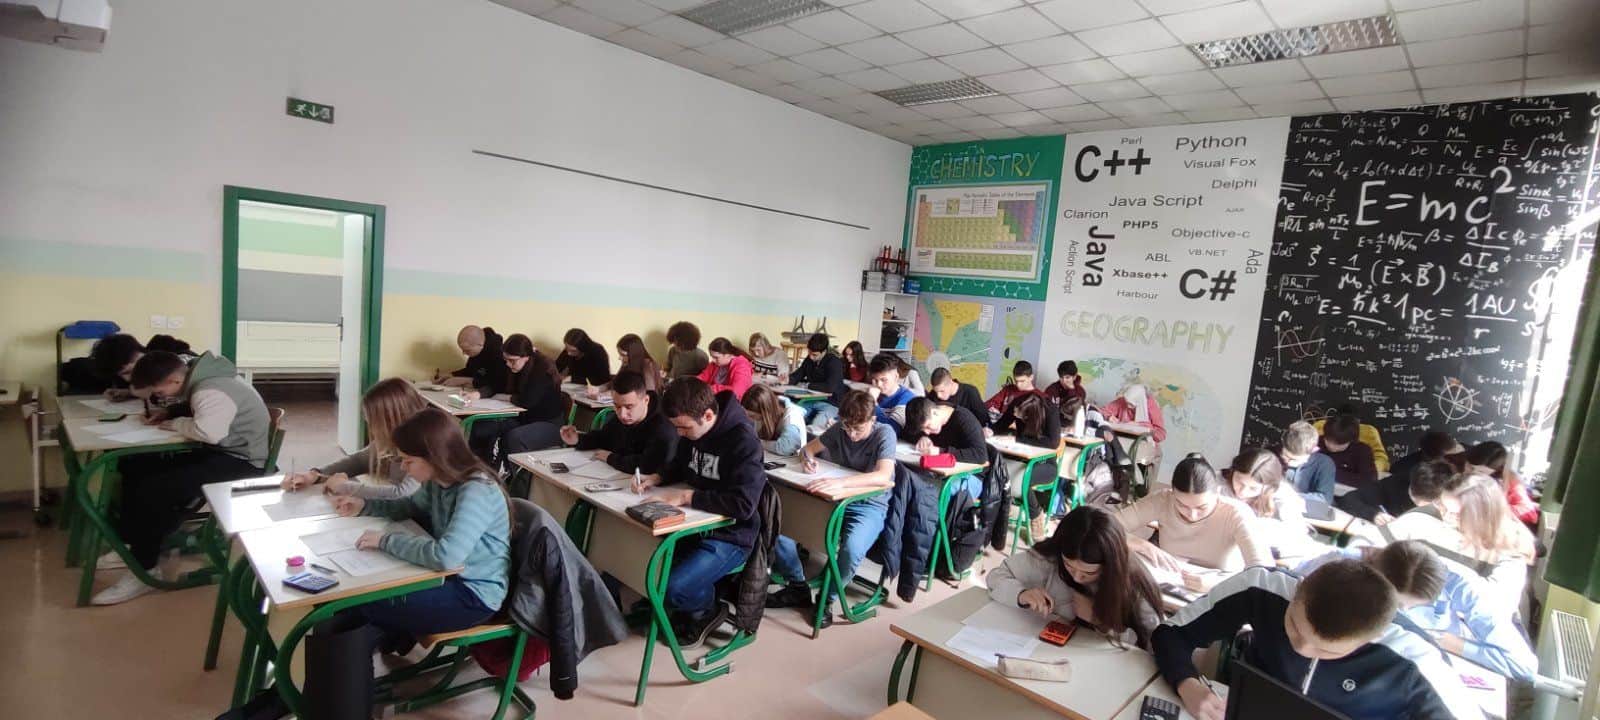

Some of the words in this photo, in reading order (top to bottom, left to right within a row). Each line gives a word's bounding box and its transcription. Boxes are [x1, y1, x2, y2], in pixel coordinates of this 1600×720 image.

[1121, 136, 1143, 145] Perl
[1175, 136, 1248, 153] Python
[930, 151, 1041, 180] CHEMISTRY
[1074, 145, 1152, 183] C++
[1183, 158, 1226, 169] Visual
[1229, 157, 1257, 168] Fox
[1211, 178, 1258, 191] Delphi
[1108, 194, 1147, 207] Java
[1152, 194, 1204, 208] Script
[1063, 209, 1109, 219] Clarion
[1122, 220, 1159, 230] PHP5
[1171, 227, 1251, 240] Objective-c
[1065, 239, 1080, 267] Action
[1082, 225, 1116, 288] Java
[1144, 252, 1172, 262] ABL
[1187, 248, 1228, 257] VB.NET
[1245, 249, 1265, 275] Ada
[1112, 268, 1169, 279] Xbase++
[1063, 269, 1077, 294] Script
[1179, 268, 1237, 302] C#
[1116, 290, 1159, 300] Harbour
[1059, 309, 1236, 354] GEOGRAPHY
